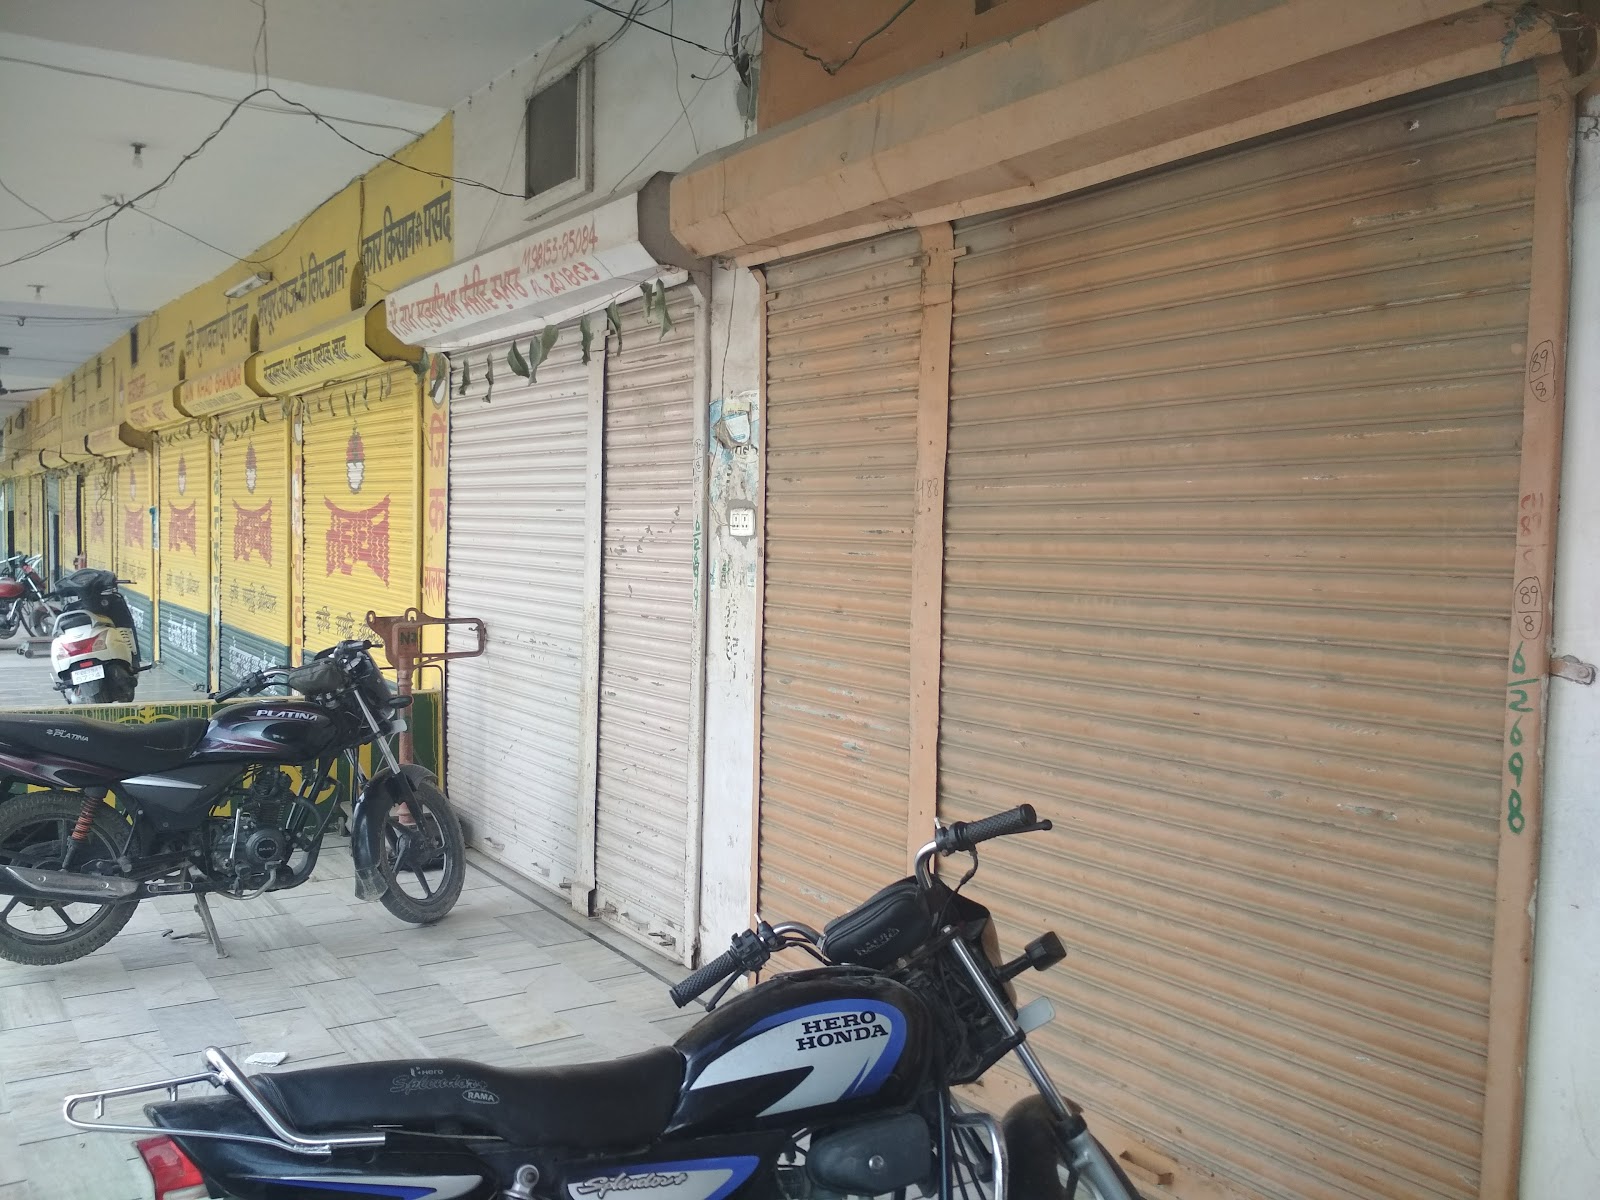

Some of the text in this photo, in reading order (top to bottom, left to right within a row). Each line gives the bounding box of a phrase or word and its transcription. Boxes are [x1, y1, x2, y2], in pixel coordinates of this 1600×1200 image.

[1531, 348, 1549, 373] 89
[1535, 381, 1547, 398] 8
[1520, 585, 1540, 609] 89
[1523, 615, 1535, 632] 8
[256, 709, 318, 721] PLATINA
[53, 730, 89, 741] PLATINA
[801, 1011, 877, 1034] HERO
[796, 1024, 889, 1051] HONDA
[467, 1091, 496, 1102] RAMA
